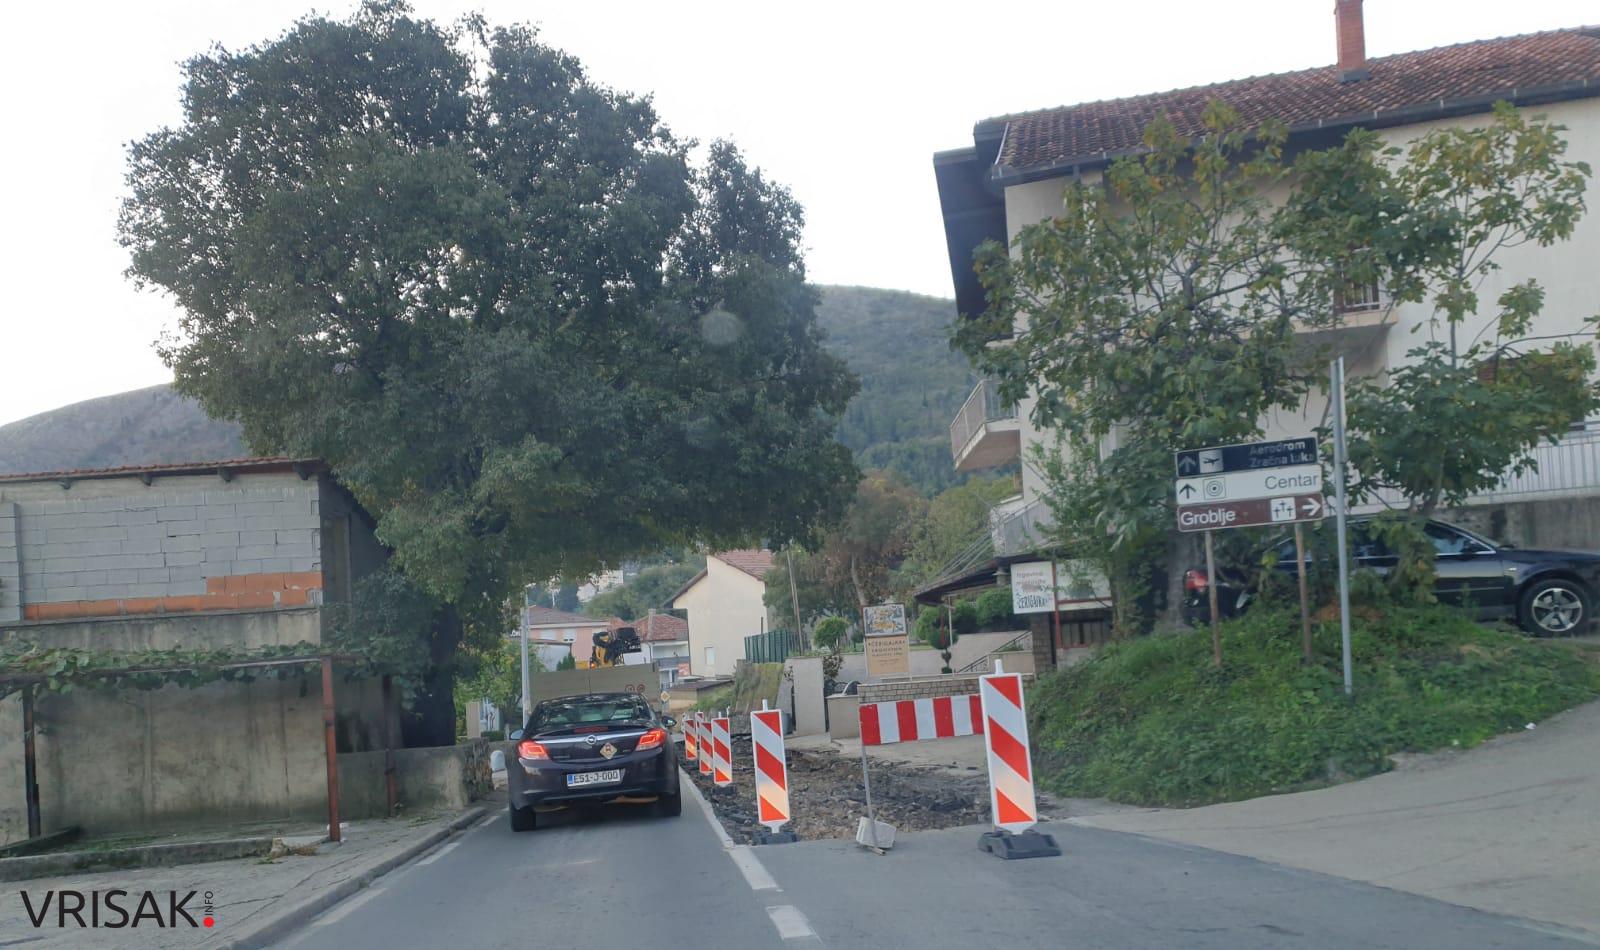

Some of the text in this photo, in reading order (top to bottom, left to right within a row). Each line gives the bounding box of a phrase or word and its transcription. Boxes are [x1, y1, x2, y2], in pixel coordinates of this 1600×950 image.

[1250, 441, 1306, 455] Aerodrom
[1264, 474, 1319, 490] Centar
[1180, 508, 1236, 526] Groblje
